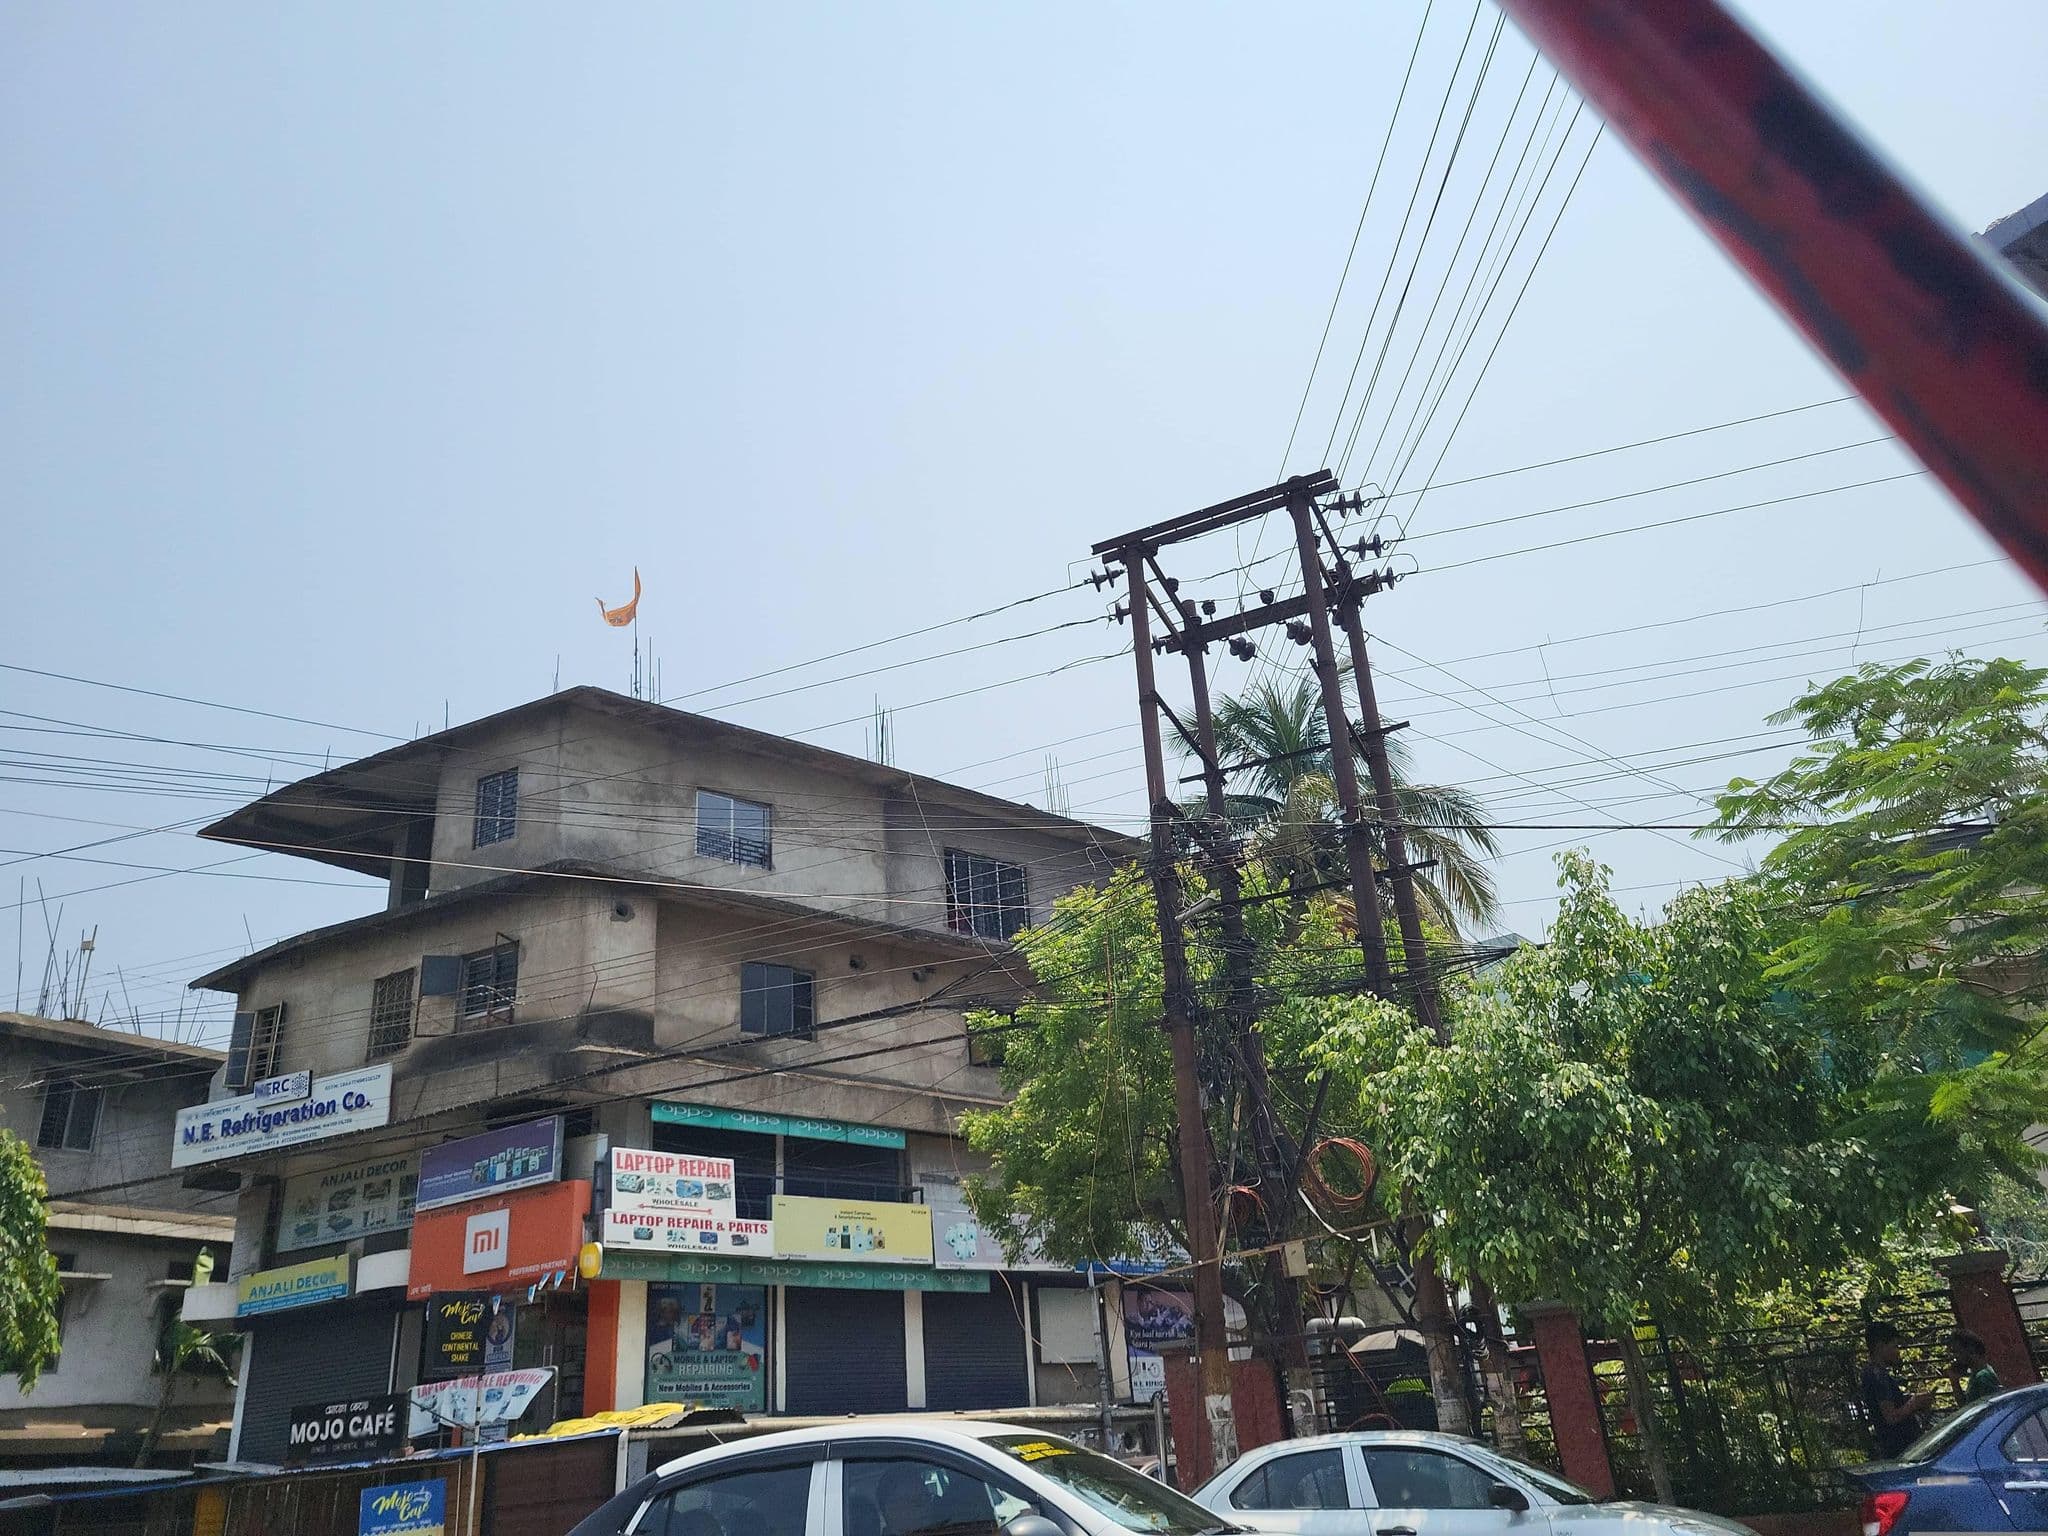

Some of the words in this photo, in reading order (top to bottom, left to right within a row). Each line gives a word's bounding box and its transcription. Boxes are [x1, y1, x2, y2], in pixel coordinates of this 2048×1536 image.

[183, 1122, 214, 1145] N.E.
[221, 1099, 336, 1138] Refrigeration
[342, 1091, 371, 1111] Co.
[320, 1168, 364, 1187] ANJALI
[367, 1159, 408, 1178] DECOR
[615, 1152, 675, 1174] LAPTOP
[679, 1158, 732, 1180] REPAIR
[652, 1199, 699, 1208] WHOLESALE
[612, 1212, 664, 1227] LAPTOP
[667, 1215, 713, 1231] REPAIR
[716, 1222, 725, 1231] &
[728, 1222, 768, 1235] PARTS
[667, 1243, 719, 1251] WHOLESALE
[248, 1279, 293, 1299] ANJALI
[451, 1331, 472, 1340] CHINESE
[442, 1342, 479, 1352] CONTINENTAL
[451, 1354, 469, 1362] SHAKE
[679, 1364, 734, 1375] REPAIRING
[658, 1384, 674, 1392] New
[675, 1383, 702, 1392] Mobiles
[703, 1383, 709, 1391] &
[711, 1383, 751, 1391] Accessories
[290, 1419, 344, 1445] MOJO
[349, 1404, 395, 1438] CAFÉ
[372, 1490, 413, 1515] Mojo
